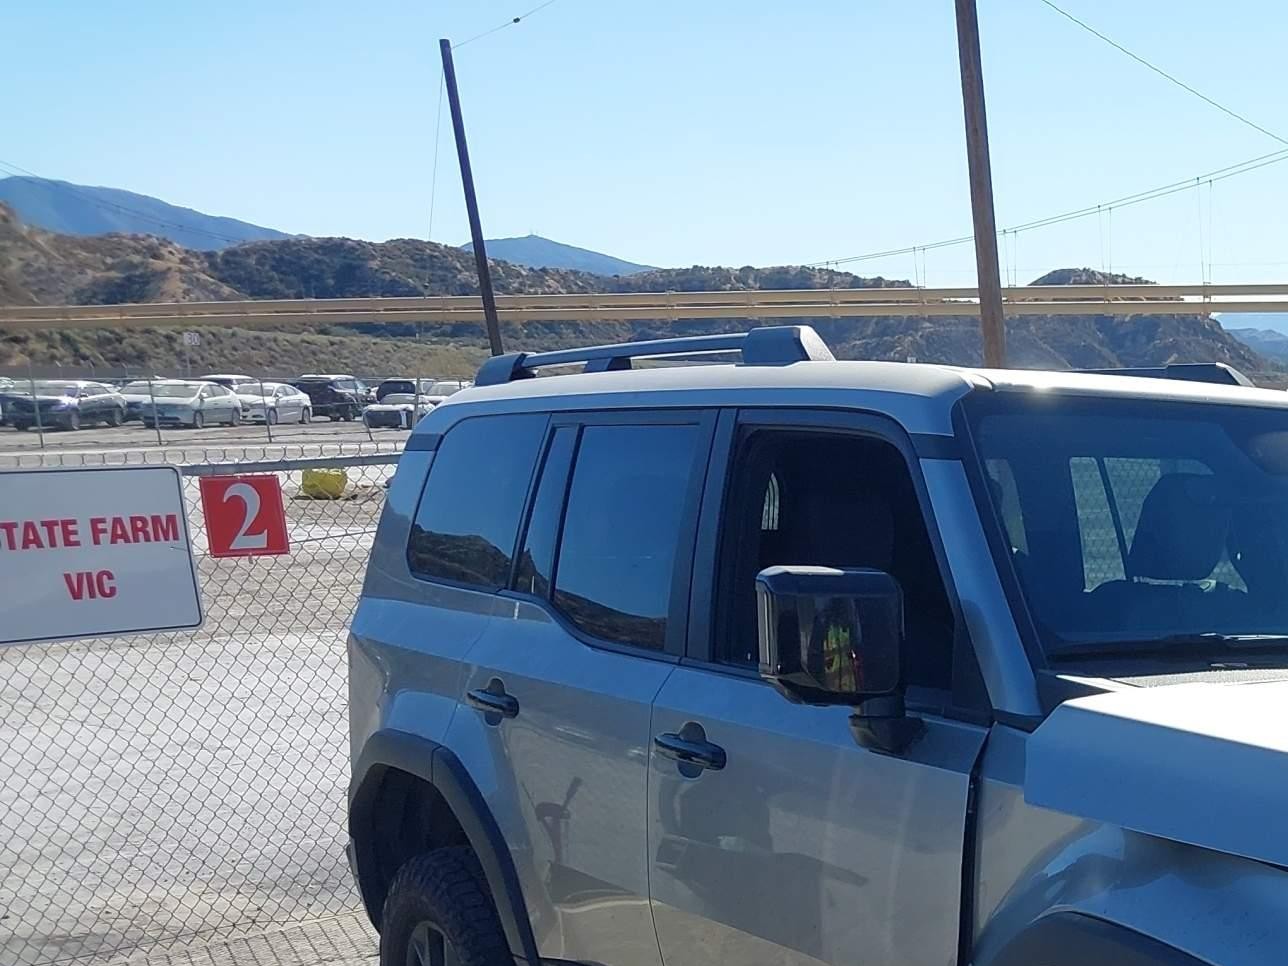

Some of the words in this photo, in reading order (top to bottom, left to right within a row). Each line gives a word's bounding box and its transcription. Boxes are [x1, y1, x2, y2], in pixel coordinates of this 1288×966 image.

[0, 519, 81, 551] TATE
[89, 514, 180, 546] FARM
[222, 482, 268, 550] 2
[63, 569, 117, 600] VIC
